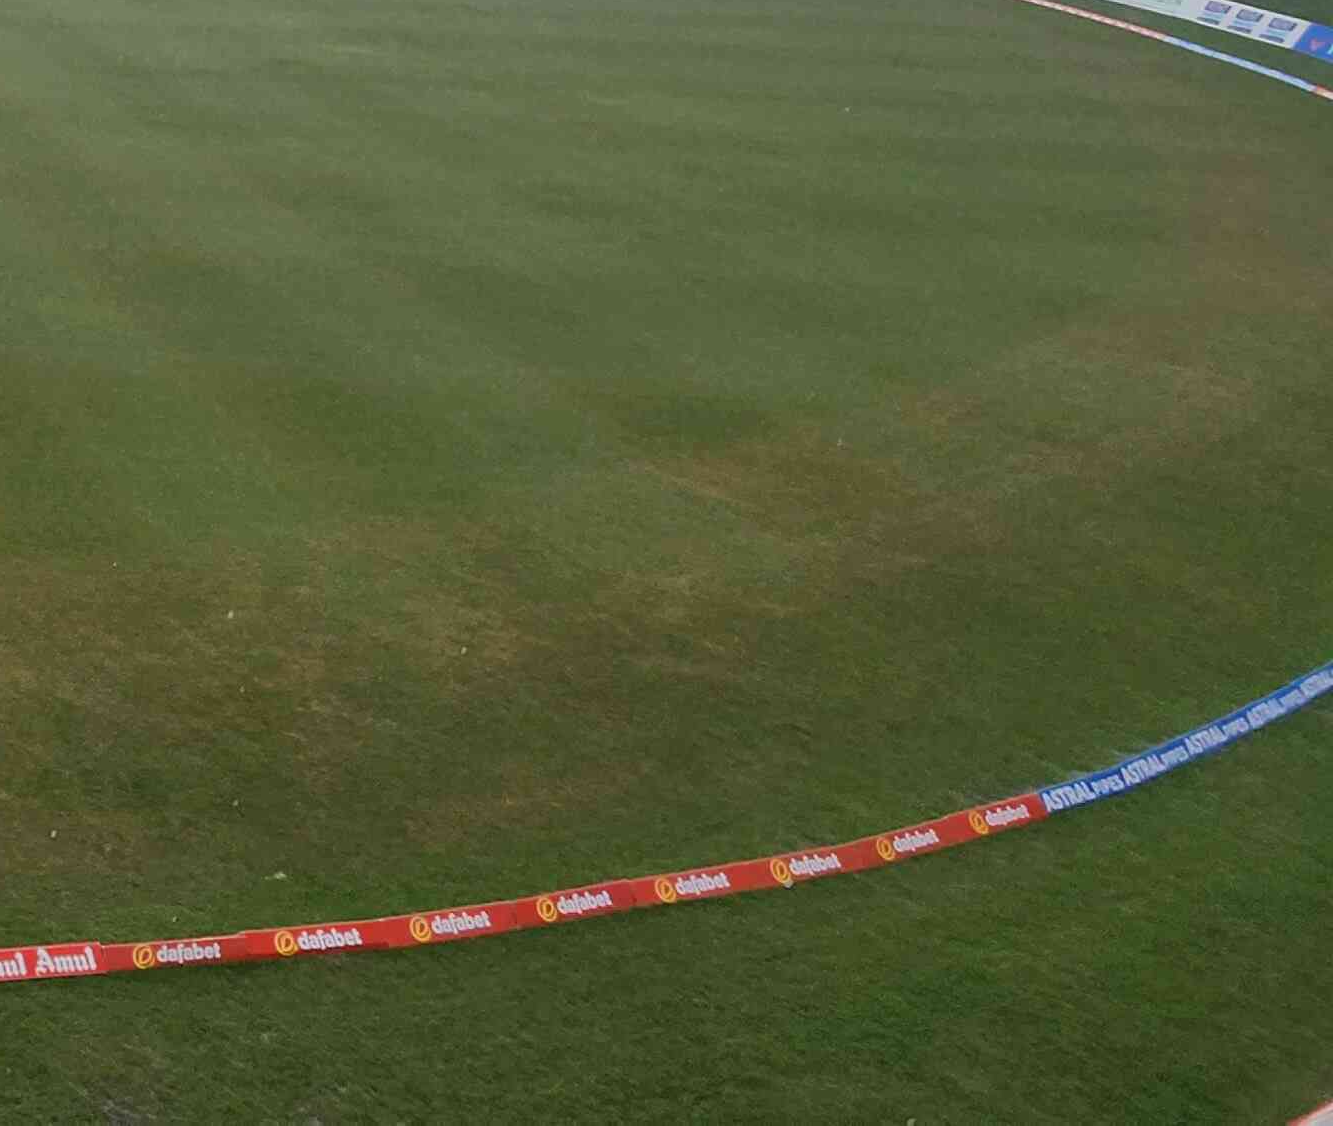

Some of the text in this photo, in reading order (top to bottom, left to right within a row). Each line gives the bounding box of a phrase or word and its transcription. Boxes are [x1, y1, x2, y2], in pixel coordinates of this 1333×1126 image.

[1246, 699, 1287, 729] ASTRAL
[1184, 726, 1228, 756] ASTRAL
[1120, 745, 1189, 786] ASTRAL PIPES
[1042, 773, 1126, 812] ASTRAL PIPES
[984, 804, 1030, 826] dafabet
[892, 828, 940, 852] dafabet
[788, 853, 842, 876] dafabet
[674, 872, 730, 896] dafabet
[556, 890, 613, 915] dafabet
[430, 910, 492, 935] dafabet
[296, 928, 363, 952] dafabet
[35, 945, 97, 977] Amul
[156, 942, 221, 964] dafabet
